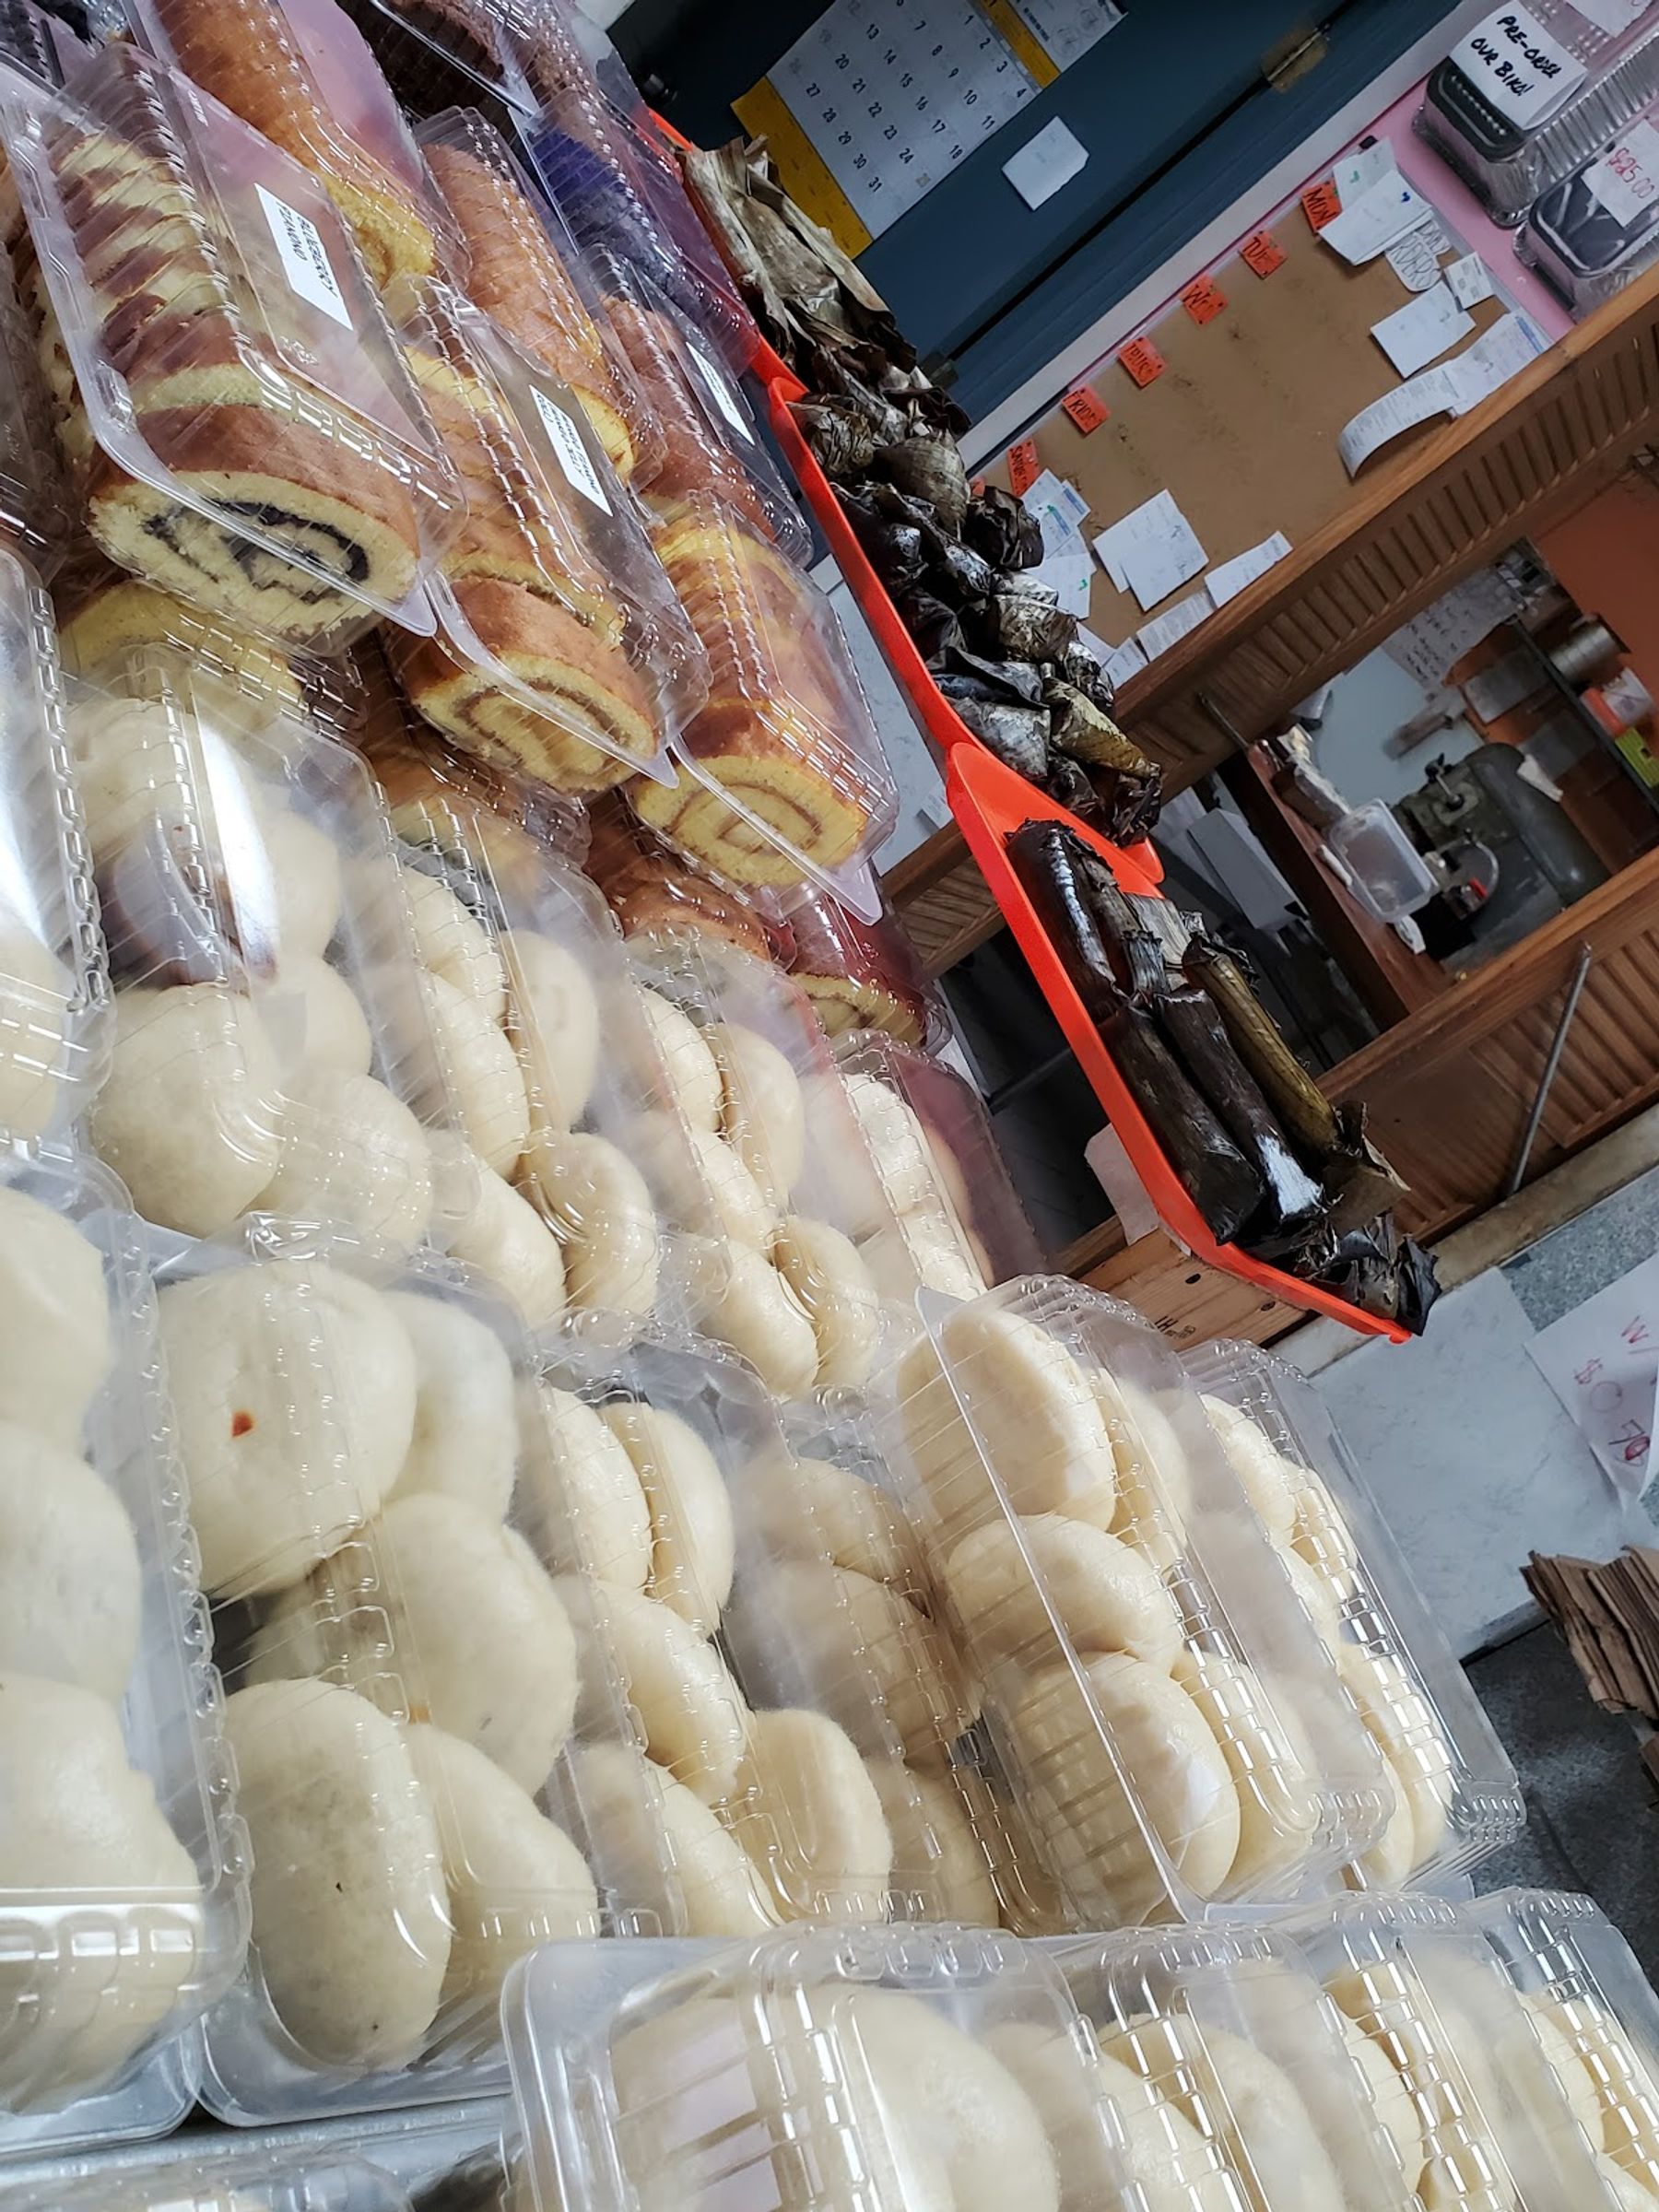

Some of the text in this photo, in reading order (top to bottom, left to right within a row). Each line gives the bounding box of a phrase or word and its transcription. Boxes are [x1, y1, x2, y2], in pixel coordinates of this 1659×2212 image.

[914, 20, 926, 29] 7
[932, 45, 942, 56] 8
[948, 67, 959, 78] 9
[964, 90, 977, 104] 10
[982, 116, 994, 130] 11
[965, 16, 1027, 99] 1 2 3 4
[1470, 38, 1535, 97] OUR BIKO!
[1496, 15, 1562, 79] PRE-ORDER
[835, 53, 849, 69] 20
[853, 78, 865, 93] 21
[868, 102, 881, 117] 22
[884, 125, 897, 139] 23
[900, 148, 913, 163] 24
[867, 24, 878, 40] 13
[885, 50, 896, 65] 14
[900, 74, 912, 88] 15
[916, 97, 928, 111] 16
[933, 120, 946, 133] 17
[950, 145, 962, 159] 18
[806, 83, 820, 97] 27
[823, 108, 836, 123] 28
[839, 131, 851, 145] 29
[853, 154, 866, 169] 30
[869, 177, 882, 192] 31
[276, 202, 308, 261] PIANONO
[297, 216, 339, 299] BLUEBERRY
[1390, 237, 1441, 288] RDERS
